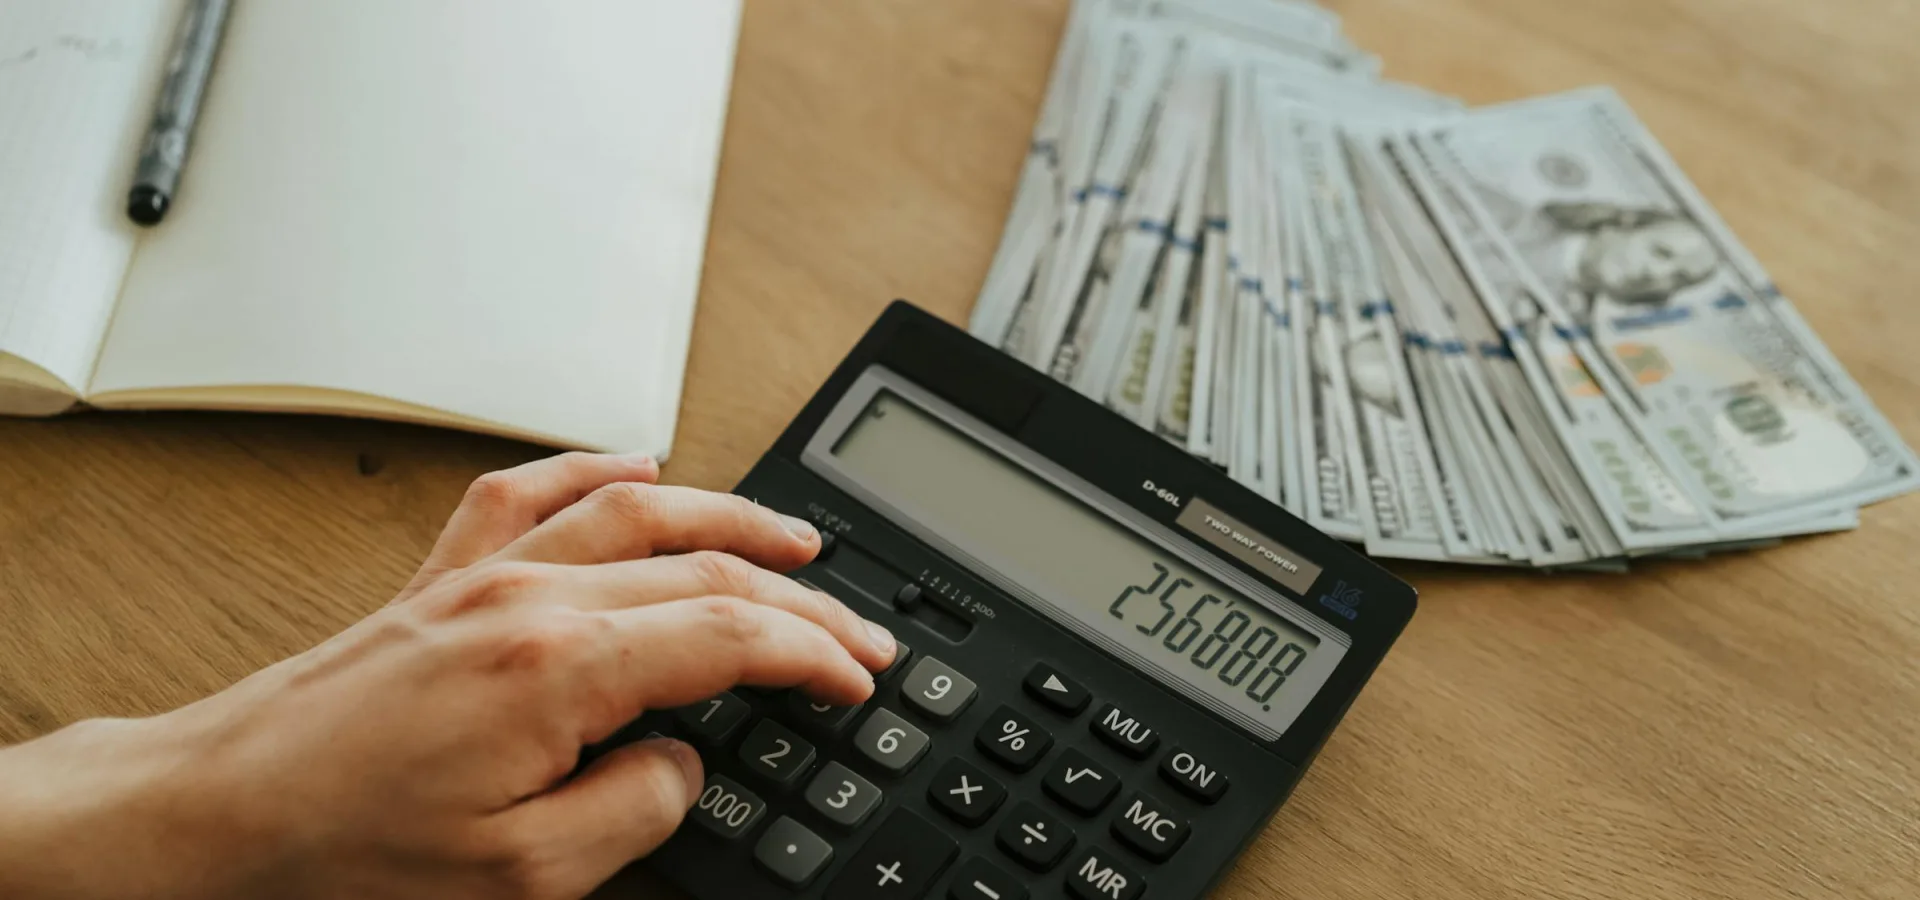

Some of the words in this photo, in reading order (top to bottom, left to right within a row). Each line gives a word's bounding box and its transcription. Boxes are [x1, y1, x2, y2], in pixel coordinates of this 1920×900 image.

[1142, 479, 1181, 508] D-60L
[1203, 514, 1231, 536] TWO
[1231, 530, 1257, 549] WAY
[1256, 544, 1299, 574] POWER
[923, 675, 953, 700] 9
[701, 699, 723, 722] 1
[1102, 708, 1151, 744] MU
[876, 727, 907, 754] 6
[998, 719, 1030, 751] %
[759, 738, 791, 768] 2
[1171, 752, 1217, 788] ON
[699, 785, 752, 827] 000
[826, 780, 857, 809] 3
[1124, 799, 1176, 842] MC
[1078, 856, 1128, 900] MR
